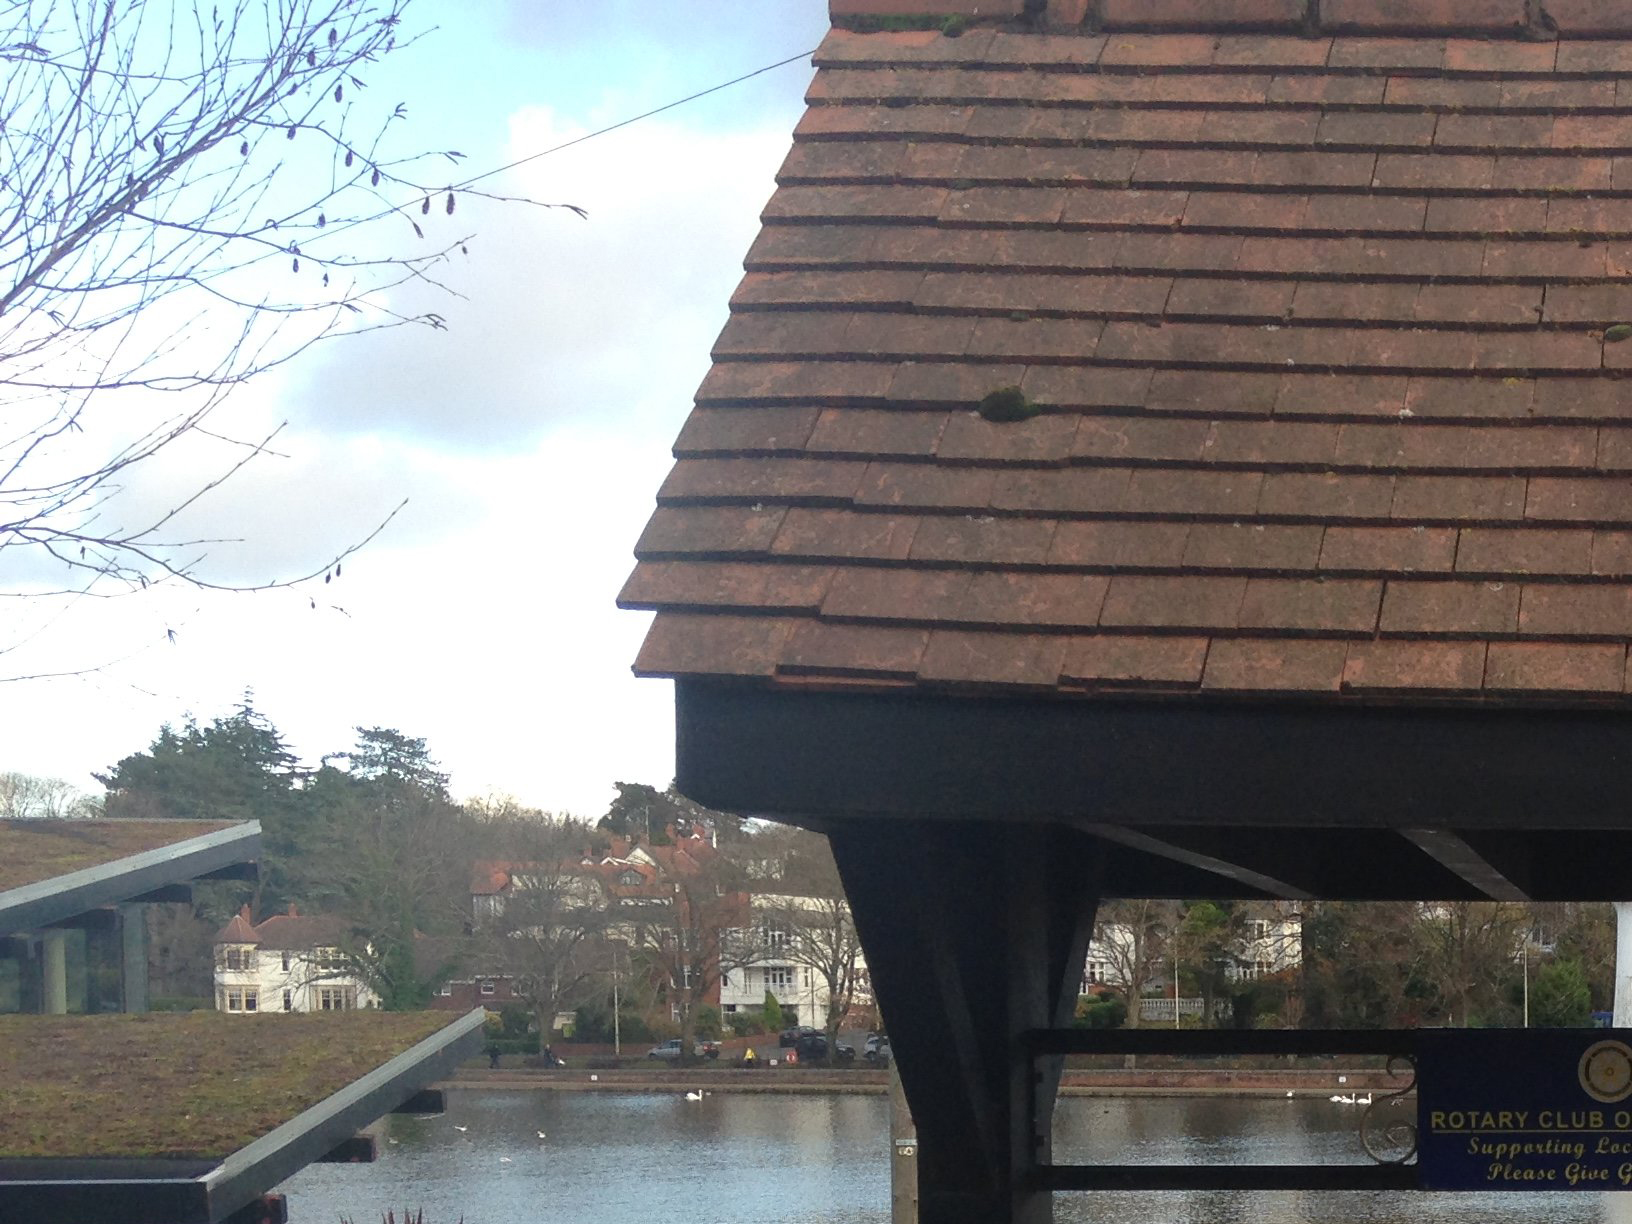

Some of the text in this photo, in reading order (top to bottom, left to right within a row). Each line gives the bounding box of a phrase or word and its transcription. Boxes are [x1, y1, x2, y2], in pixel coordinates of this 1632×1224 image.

[1431, 1111, 1529, 1129] ROTARY
[1538, 1111, 1604, 1129] CLUB
[1467, 1136, 1585, 1160] Supporting
[1487, 1162, 1557, 1181] Please
[1564, 1162, 1610, 1186] Give
